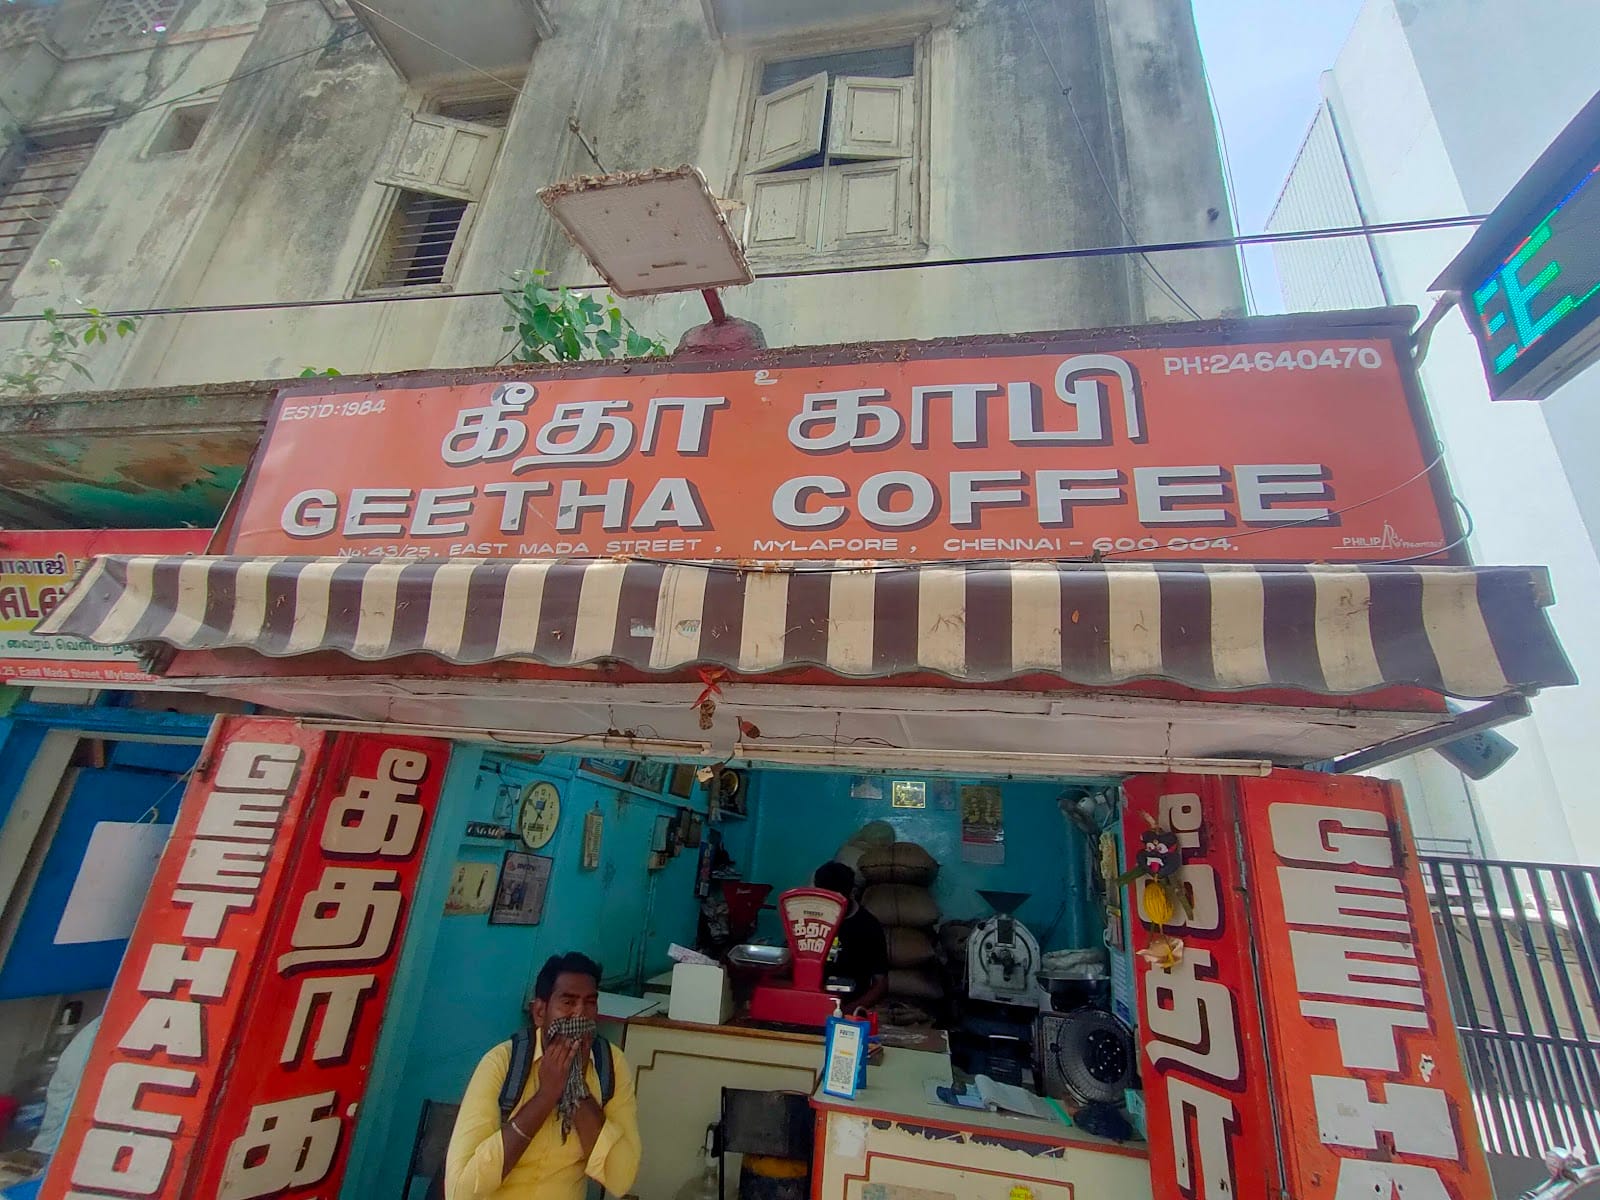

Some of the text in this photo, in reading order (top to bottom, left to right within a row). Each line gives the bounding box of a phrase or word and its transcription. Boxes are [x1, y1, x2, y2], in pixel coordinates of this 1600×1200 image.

[1164, 347, 1382, 376] PH:24640470
[280, 399, 386, 422] ESTD:1984
[440, 353, 1148, 474] கீதா காபி
[280, 462, 1342, 538] GEETHA COFFEE
[449, 542, 508, 556] EAST
[519, 541, 589, 555] MADA
[943, 537, 1061, 552] CHENNAI
[18, 667, 41, 678] East
[116, 741, 304, 1062] GEETHA
[793, 919, 832, 938] கீதா
